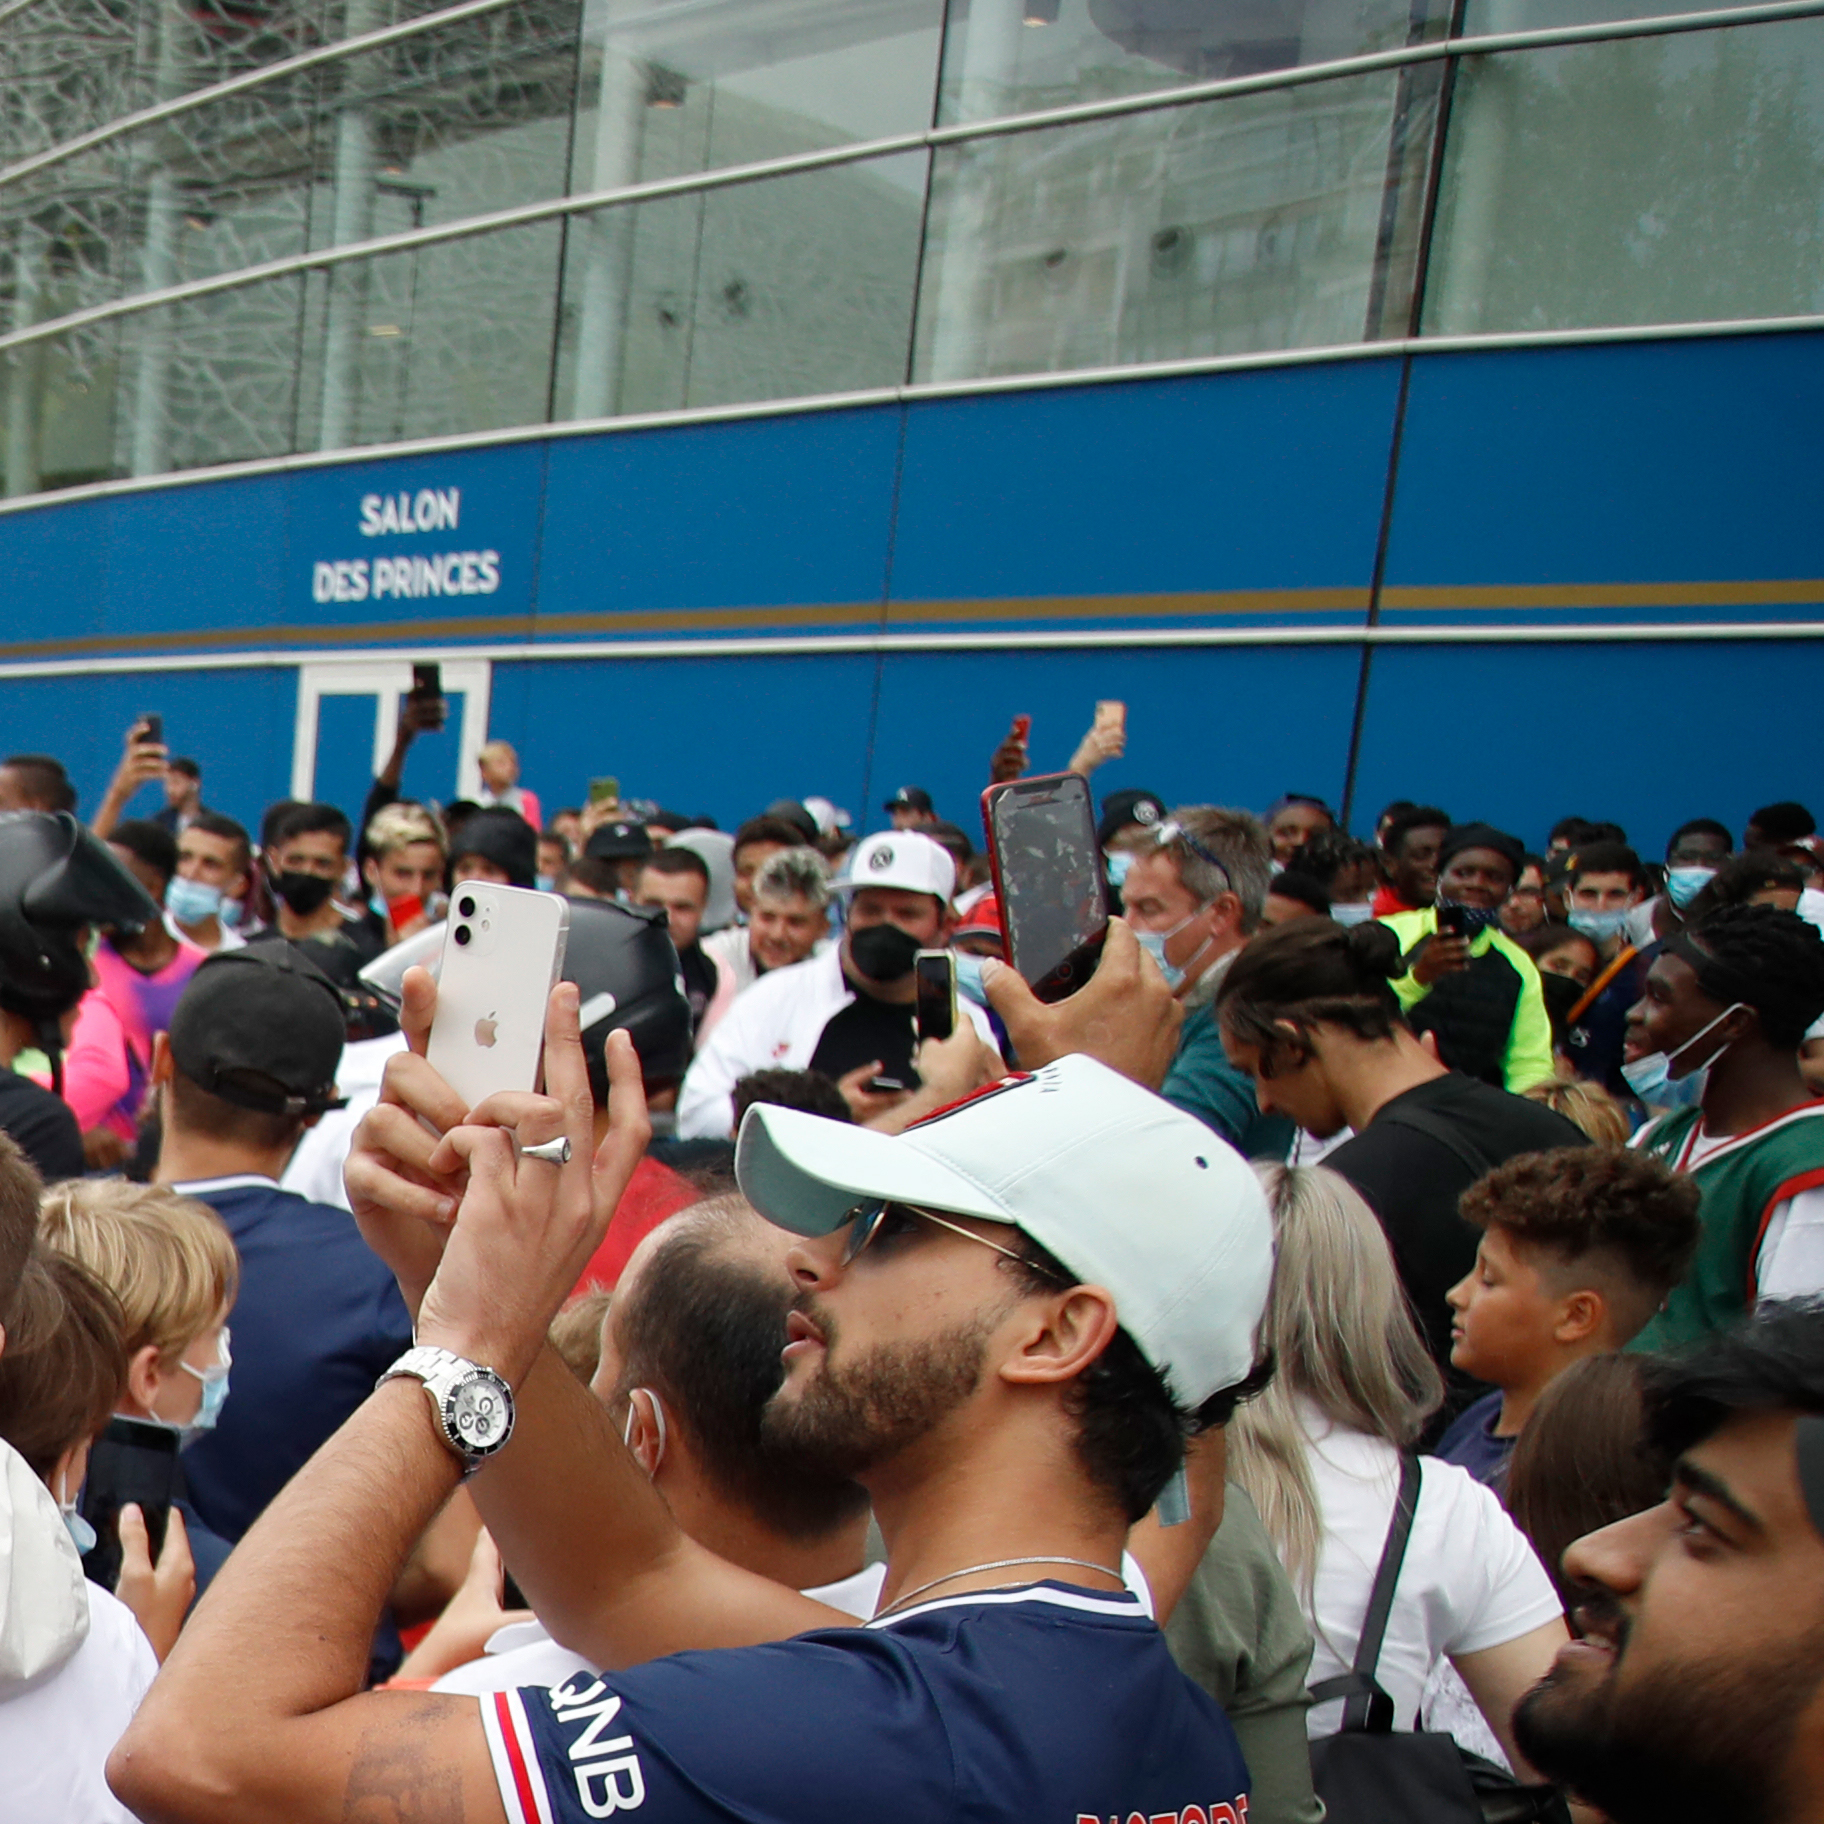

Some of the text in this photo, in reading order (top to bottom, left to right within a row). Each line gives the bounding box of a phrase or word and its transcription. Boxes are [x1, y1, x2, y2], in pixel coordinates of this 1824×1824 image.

[359, 486, 460, 537] SALON
[313, 549, 501, 603] DES PRINCES
